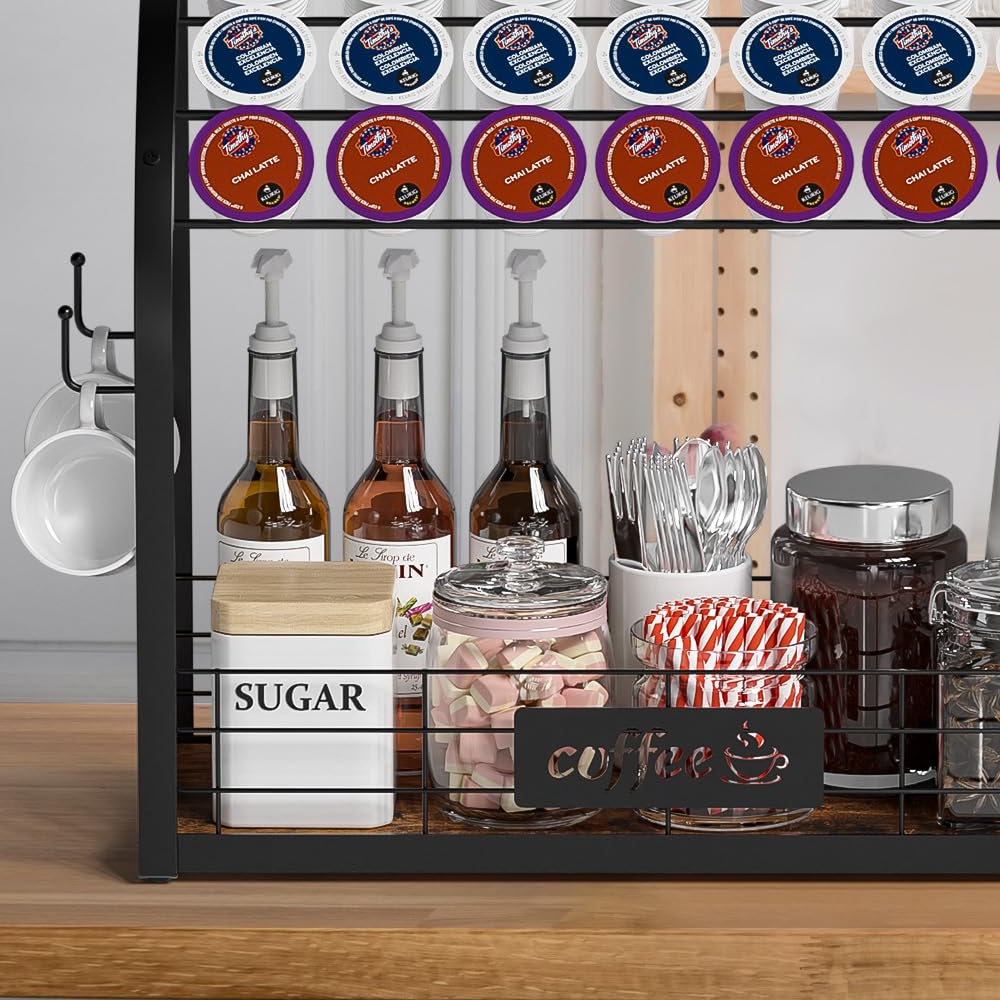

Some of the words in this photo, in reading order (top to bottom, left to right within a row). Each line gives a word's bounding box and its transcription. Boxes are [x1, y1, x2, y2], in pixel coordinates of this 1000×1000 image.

[236, 42, 272, 60] COLOMBIAN
[373, 42, 409, 60] COLOMBIAN
[507, 42, 543, 60] COLOMBIAN
[641, 42, 677, 60] COLOMBIAN
[773, 42, 809, 60] COLOMBIAN
[906, 43, 942, 61] COLOMBIAN
[231, 169, 253, 184] CHAI
[253, 155, 280, 173] LATTE
[369, 169, 391, 184] CHAI
[391, 155, 418, 173] LATTE
[504, 169, 526, 184] CHAI
[526, 155, 553, 173] LATTE
[638, 169, 660, 184] CHAI
[660, 155, 687, 173] LATTE
[771, 169, 793, 184] CHAI
[793, 155, 820, 173] LATTE
[905, 170, 927, 185] CHAI
[927, 156, 954, 174] LATTE
[235, 682, 367, 712] SUGAR
[547, 728, 713, 793] coffee
